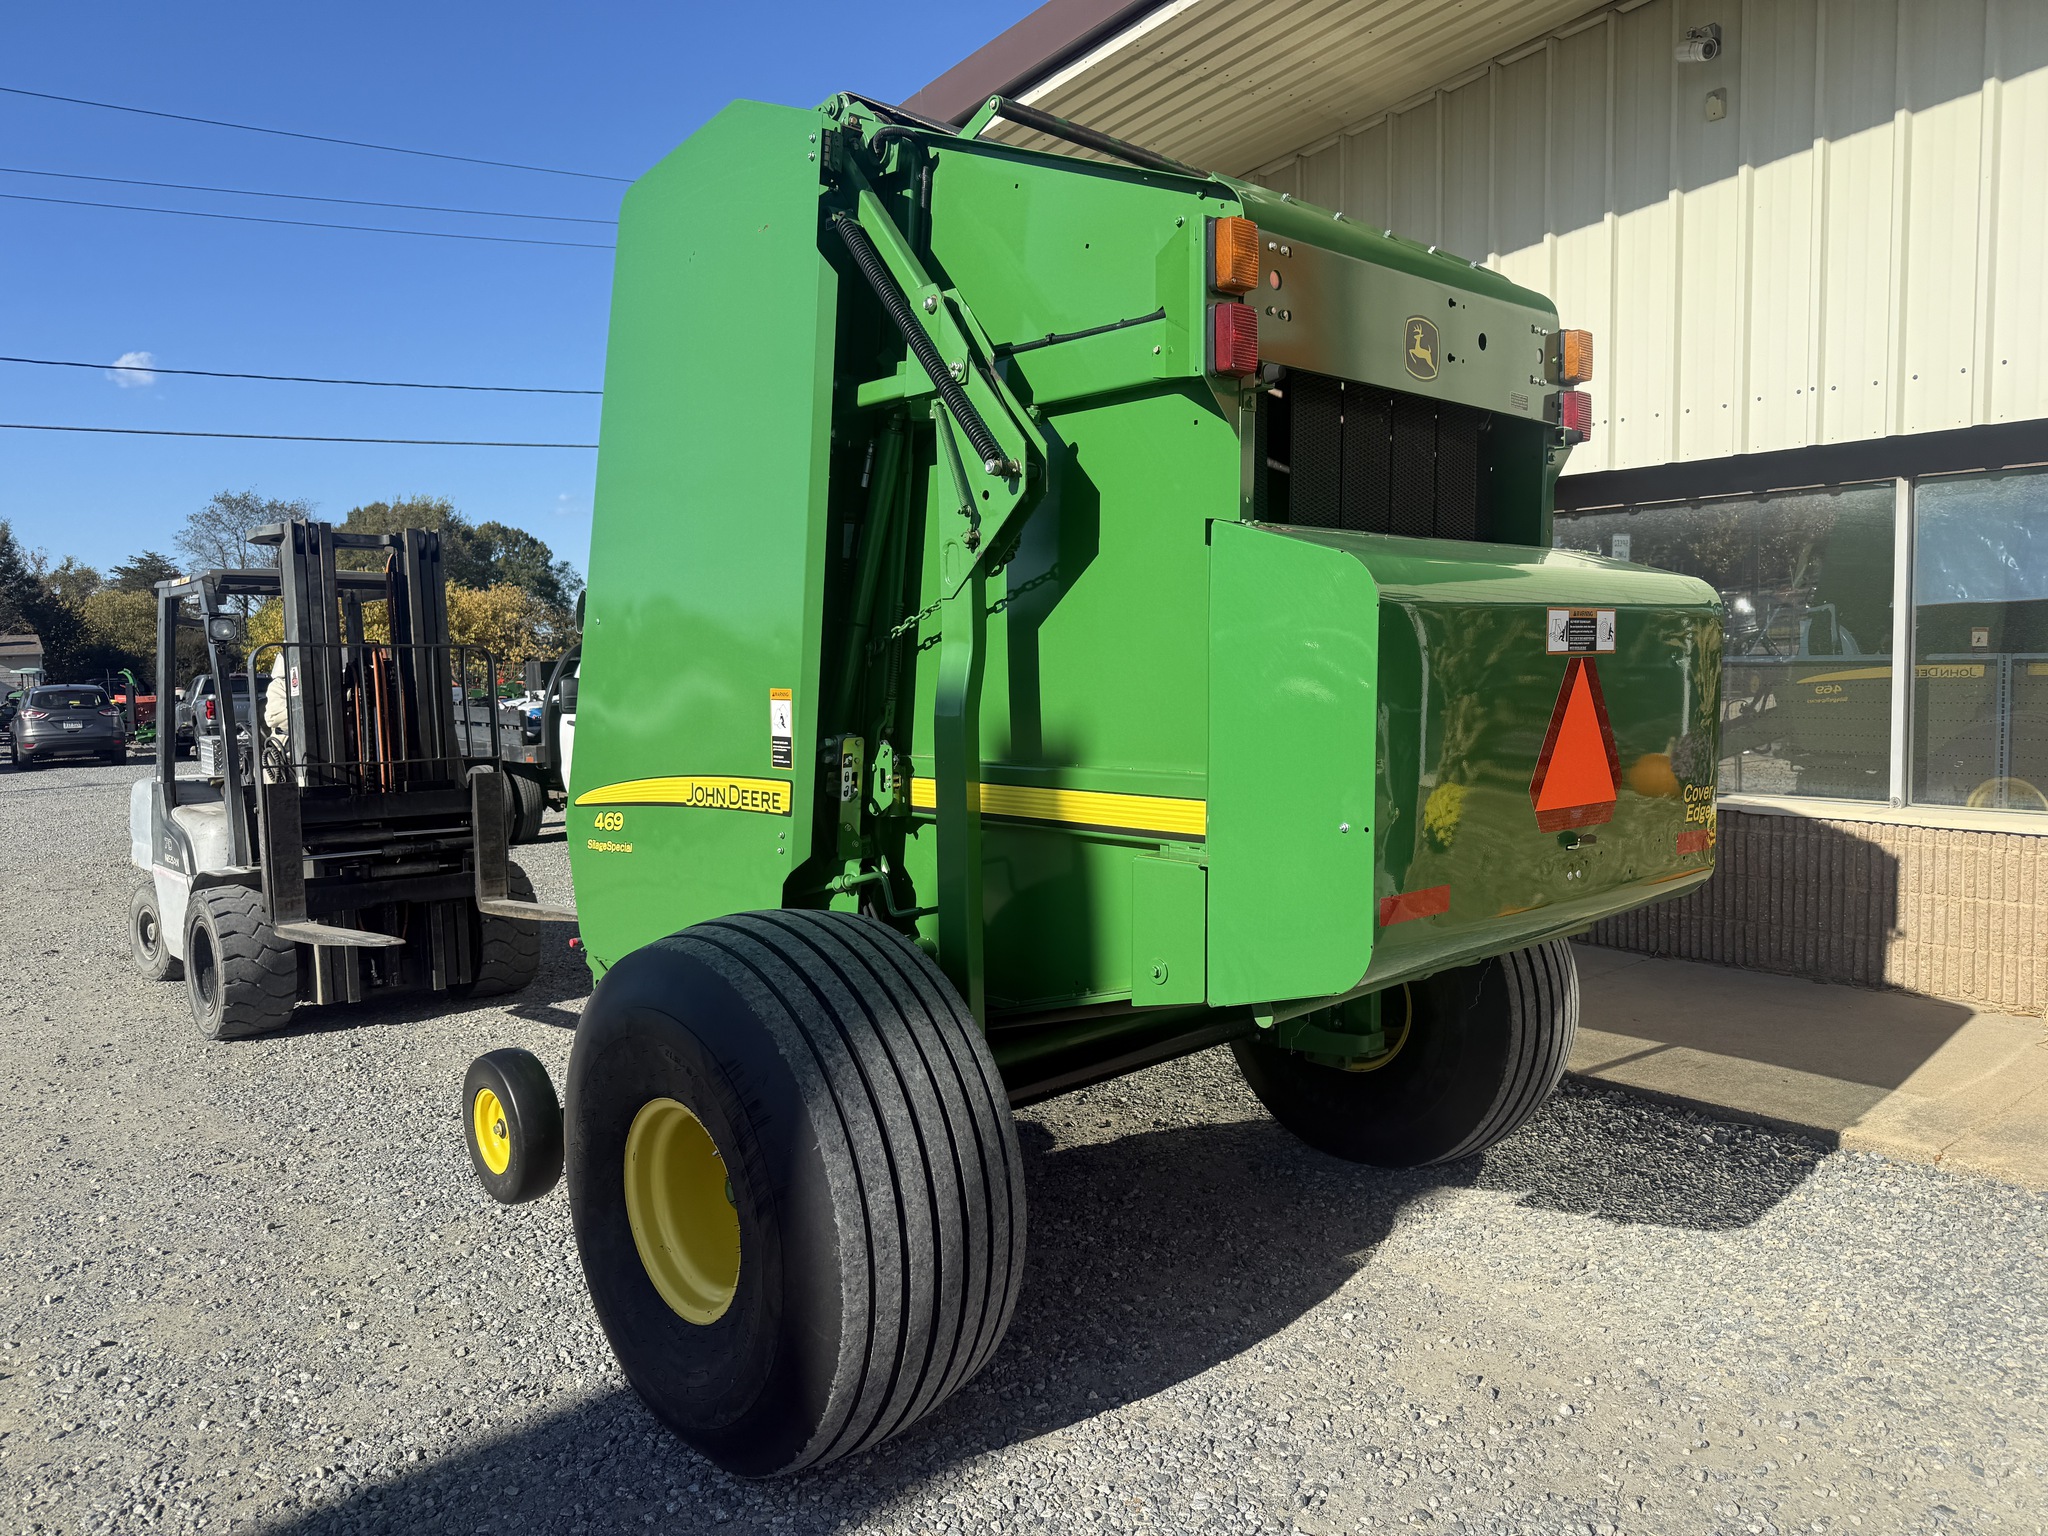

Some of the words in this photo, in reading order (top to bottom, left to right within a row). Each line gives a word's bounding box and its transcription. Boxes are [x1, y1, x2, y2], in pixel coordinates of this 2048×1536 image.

[686, 782, 726, 805] JOHN
[729, 784, 781, 810] DEERE
[1684, 783, 1713, 802] Cover
[594, 811, 624, 831] 469
[1685, 803, 1711, 824] Edge
[587, 838, 633, 853] SilageSpecial
